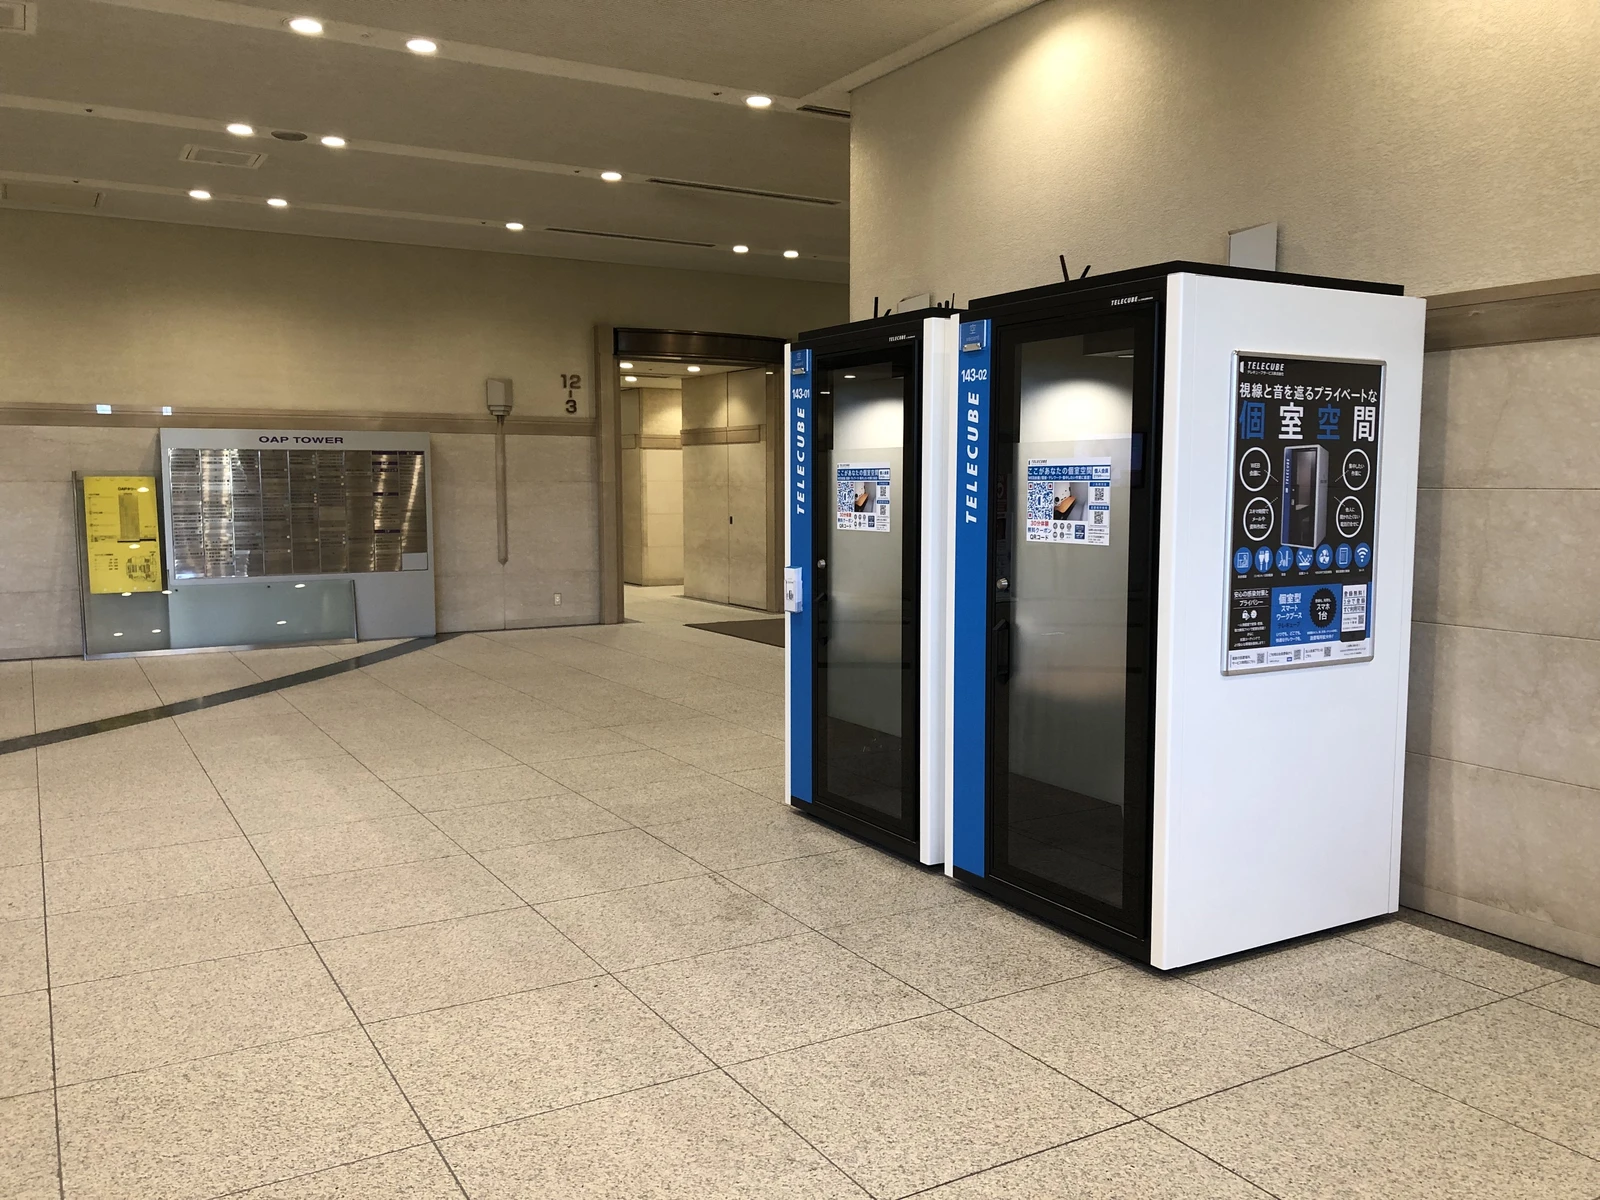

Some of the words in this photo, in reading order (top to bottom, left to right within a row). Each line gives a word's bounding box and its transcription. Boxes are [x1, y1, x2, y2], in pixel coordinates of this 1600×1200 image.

[1110, 296, 1138, 306] TELECUBE
[1247, 361, 1285, 372] TELECUBE
[961, 368, 988, 382] 143-02
[560, 374, 582, 389] 12
[792, 388, 810, 399] 143-01
[1239, 382, 1378, 403] 視線と音を遮るプライベートな
[565, 399, 578, 414] 3
[259, 436, 289, 444] OAP
[293, 436, 344, 444] TOWER
[796, 407, 805, 515] TELECUBE
[965, 391, 980, 524] TELECUBE
[1028, 466, 1093, 476] ここがあなたの個室空間
[1239, 599, 1264, 607] プライバシー
[1278, 593, 1302, 605] 個室型
[1281, 604, 1299, 612] スマート
[1316, 603, 1331, 611] スマホ
[1276, 612, 1303, 621] ワークブース
[1317, 611, 1329, 621] 1台
